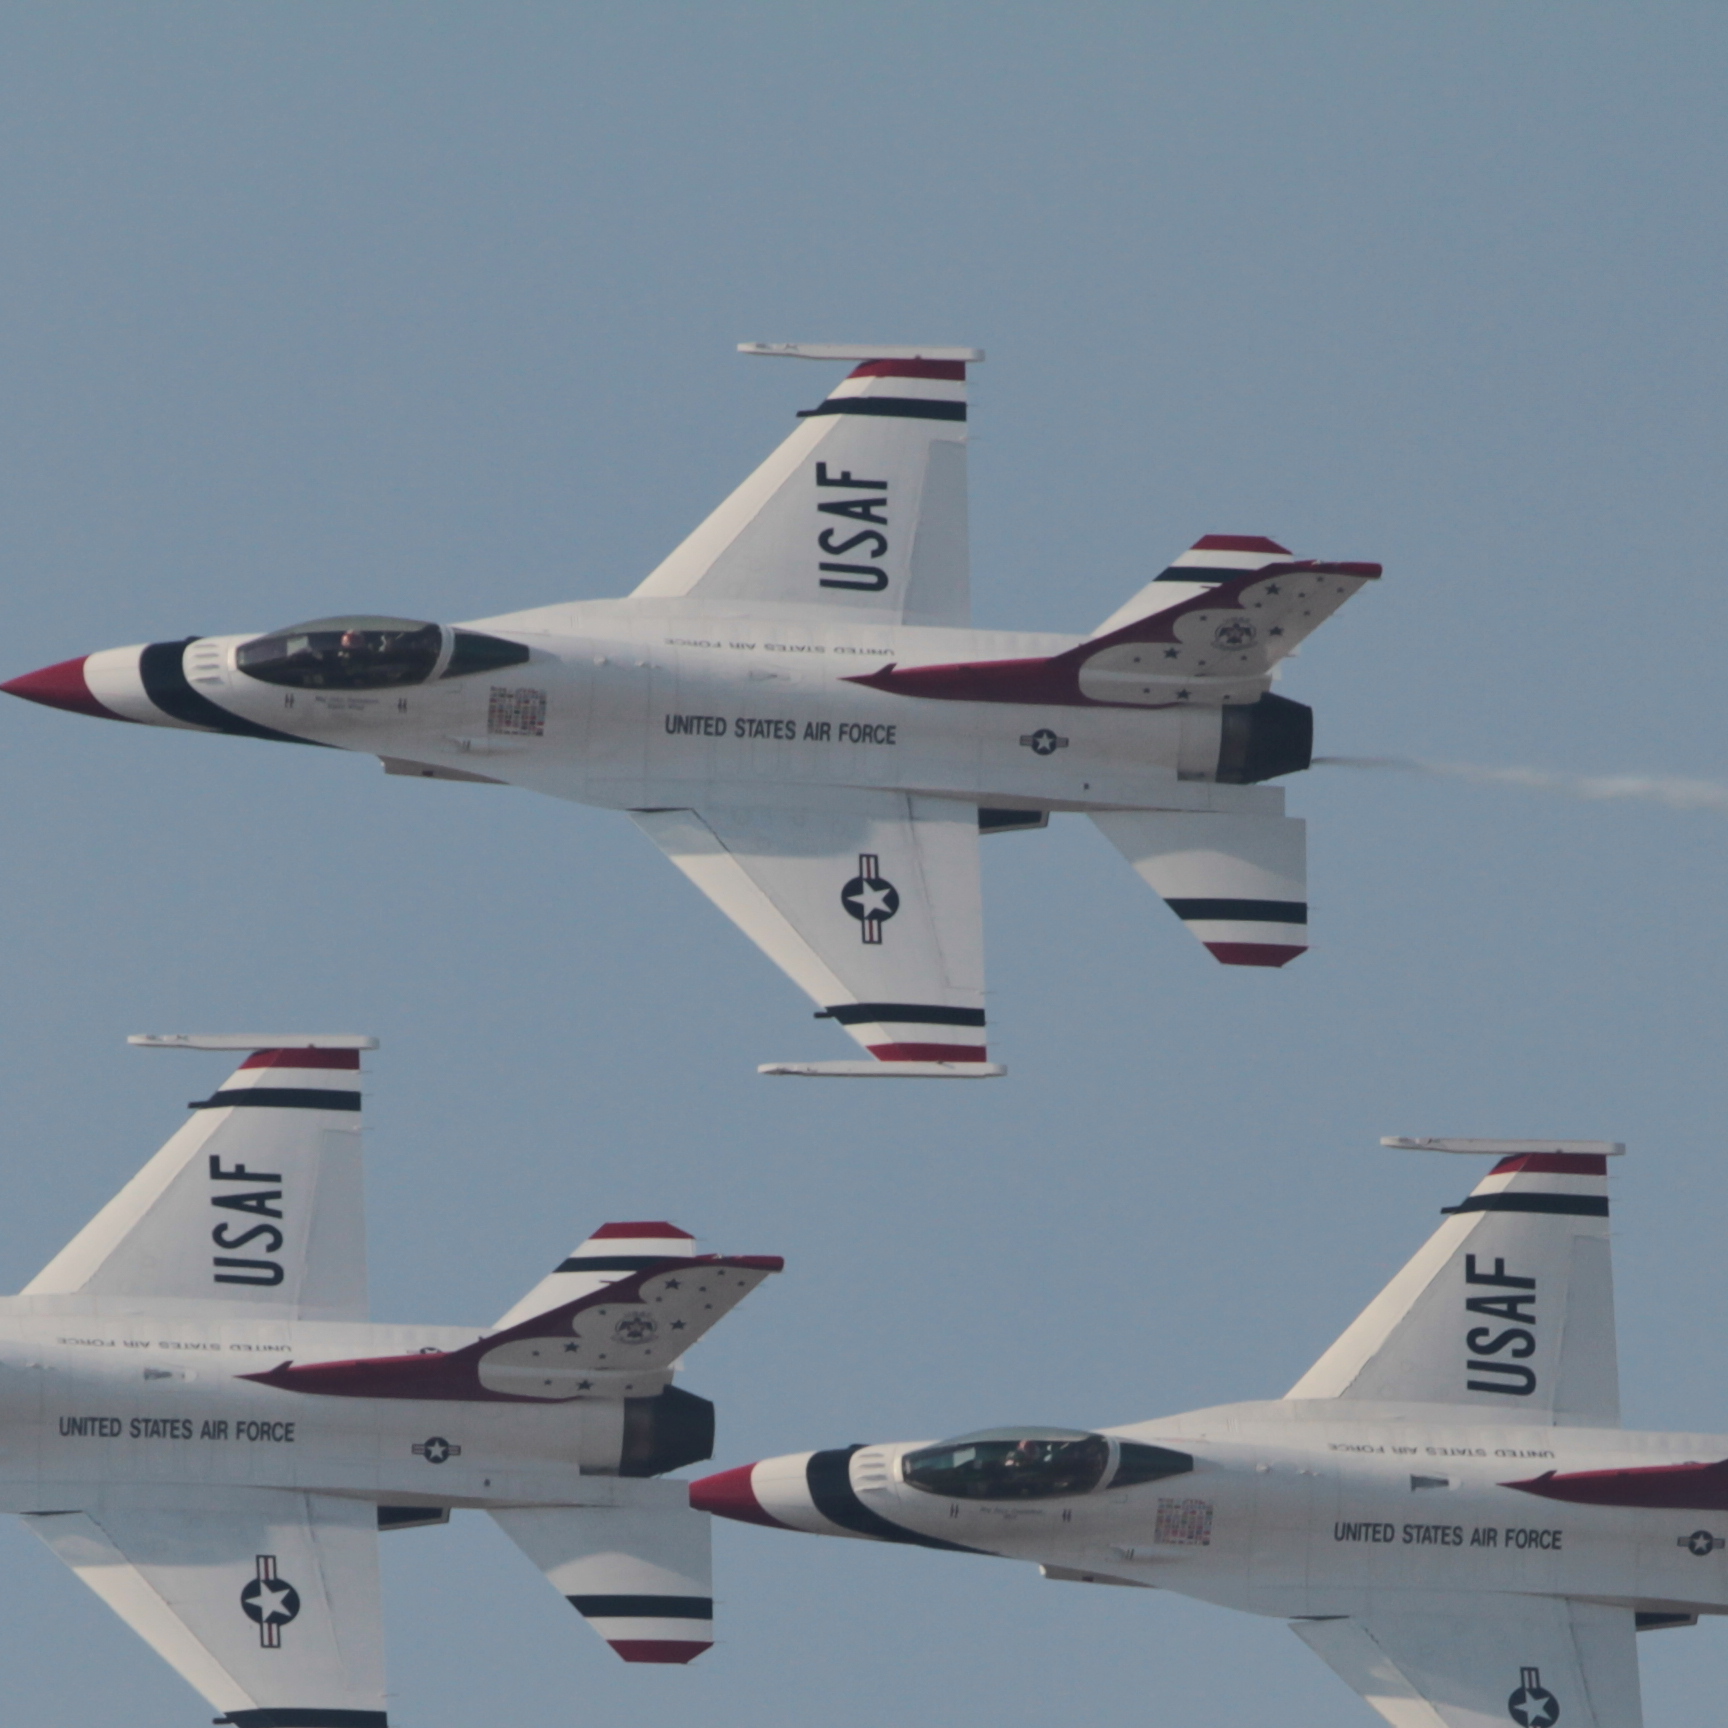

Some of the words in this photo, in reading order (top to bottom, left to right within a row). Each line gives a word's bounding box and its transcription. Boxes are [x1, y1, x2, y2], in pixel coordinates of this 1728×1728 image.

[816, 462, 889, 592] USAF
[665, 714, 727, 736] UNITED
[735, 717, 796, 740] STATES
[803, 722, 831, 741] AIR
[838, 723, 897, 745] FORCE
[209, 1154, 284, 1286] USAF
[1465, 1254, 1536, 1396] USAF
[59, 1416, 122, 1438] UNITED
[130, 1418, 193, 1440] STATES
[200, 1420, 228, 1441] AIR
[236, 1421, 295, 1442] FORCE
[1333, 1522, 1395, 1542] UNITED
[1402, 1524, 1463, 1546] STATES
[1470, 1527, 1498, 1547] AIR
[1505, 1528, 1563, 1550] FORCE
